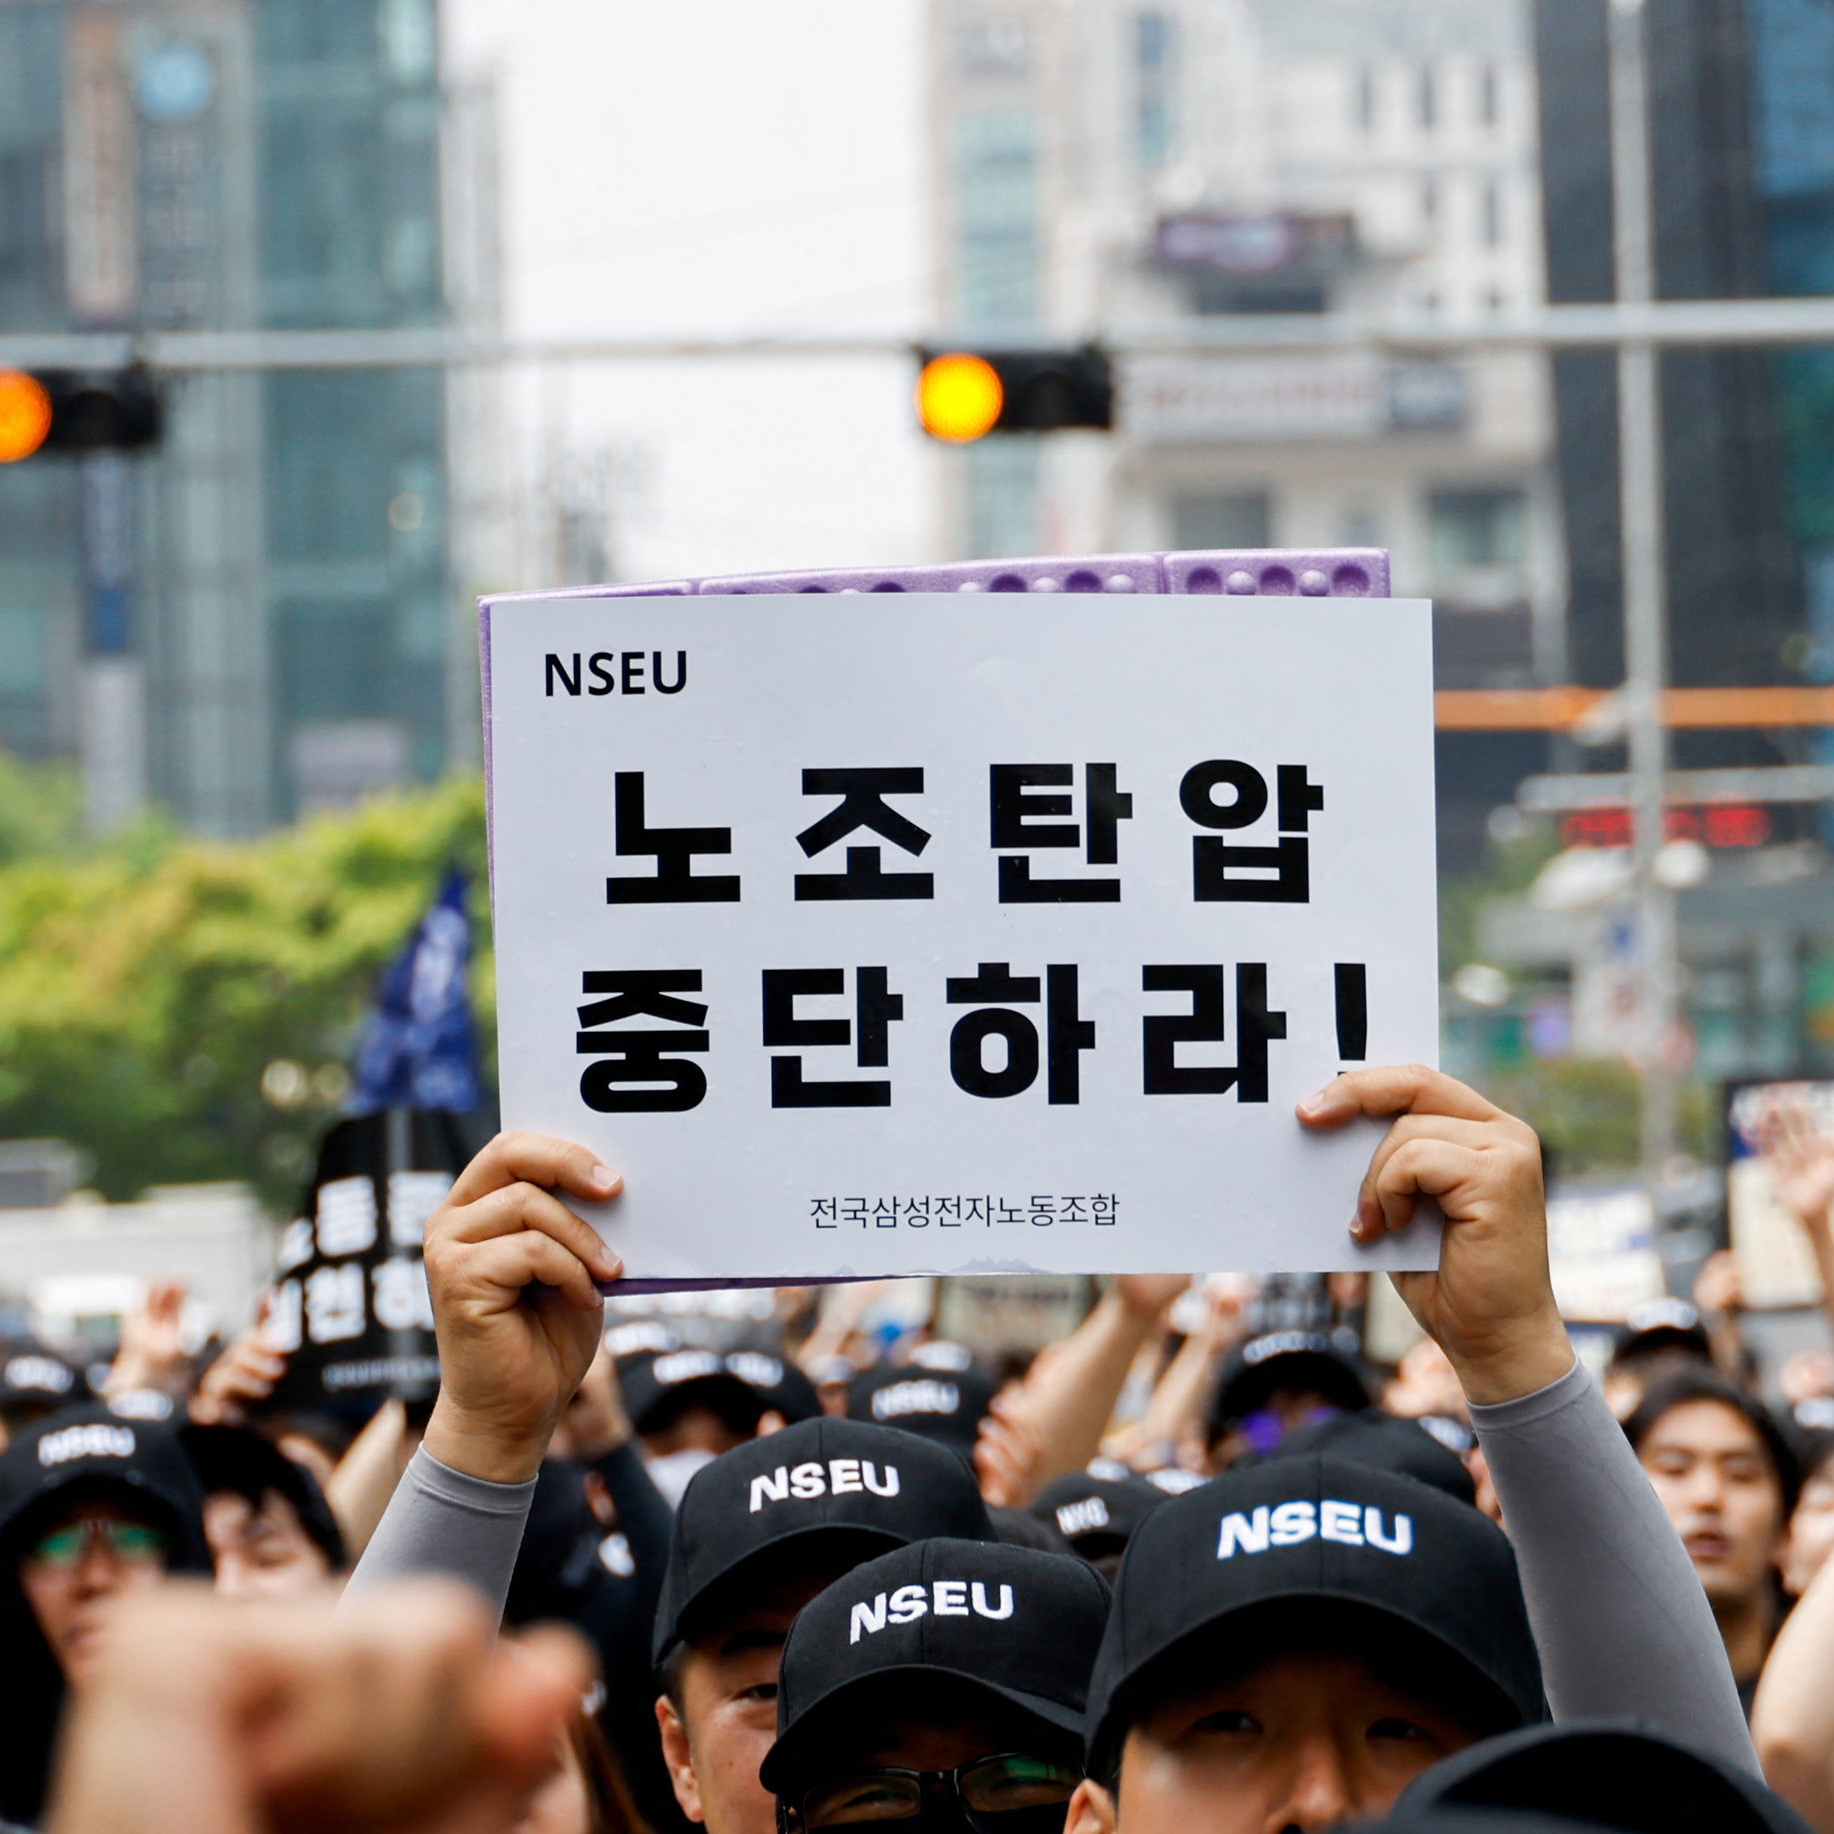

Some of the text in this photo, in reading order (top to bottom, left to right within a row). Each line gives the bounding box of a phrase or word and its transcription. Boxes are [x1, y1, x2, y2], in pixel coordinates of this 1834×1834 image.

[544, 649, 689, 697] NSEU
[605, 759, 1324, 905] 노조탄압
[574, 961, 1367, 1115] 중단하라!
[808, 1191, 1121, 1230] 전국삼성전자노동조합
[749, 1458, 901, 1512] NSEU
[1217, 1498, 1416, 1560] NSEU
[849, 1580, 1015, 1645] NSEU
